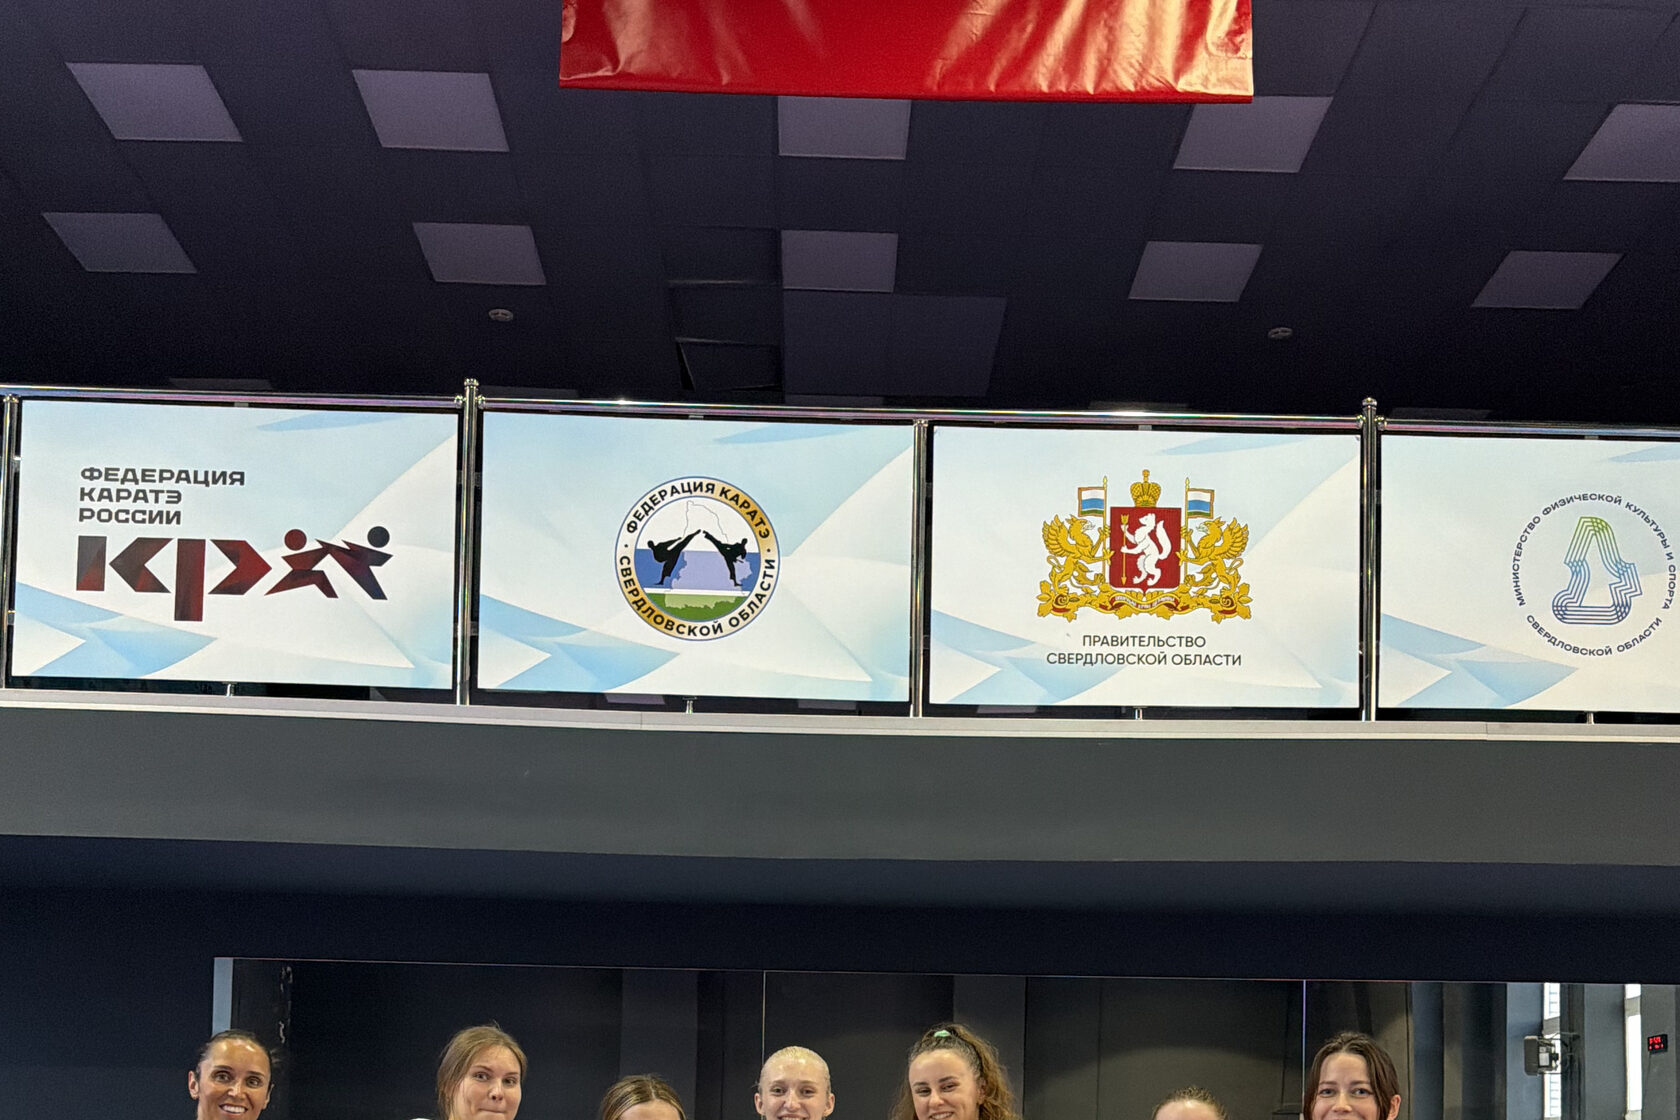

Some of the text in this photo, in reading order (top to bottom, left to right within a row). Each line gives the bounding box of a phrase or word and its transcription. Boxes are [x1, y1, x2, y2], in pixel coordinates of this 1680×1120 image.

[81, 467, 245, 487] ФЕДЕРАЦИЯ
[80, 488, 182, 504] КАРАТЭ
[78, 508, 182, 525] РОССИИ
[626, 481, 770, 539] ФЕДЕРАЦИЯ КАРАТЭ
[1512, 493, 1677, 610] МИНИСТЕРСТВО ФИЗИЧЕСКОЙ КУЛЬТУРЫ И СПОРТА
[619, 555, 776, 637] СВЕРДЛОВСКОЙ ОБЛАСТИ
[1082, 635, 1206, 648] ПРАВИТЕЛЬСТВО
[1526, 614, 1663, 657] СВЕРДЛОВСКОЙ ОБЛАСТИ
[1046, 652, 1242, 667] СВЕРДЛОВСКОЙ ОБЛАСТИ
